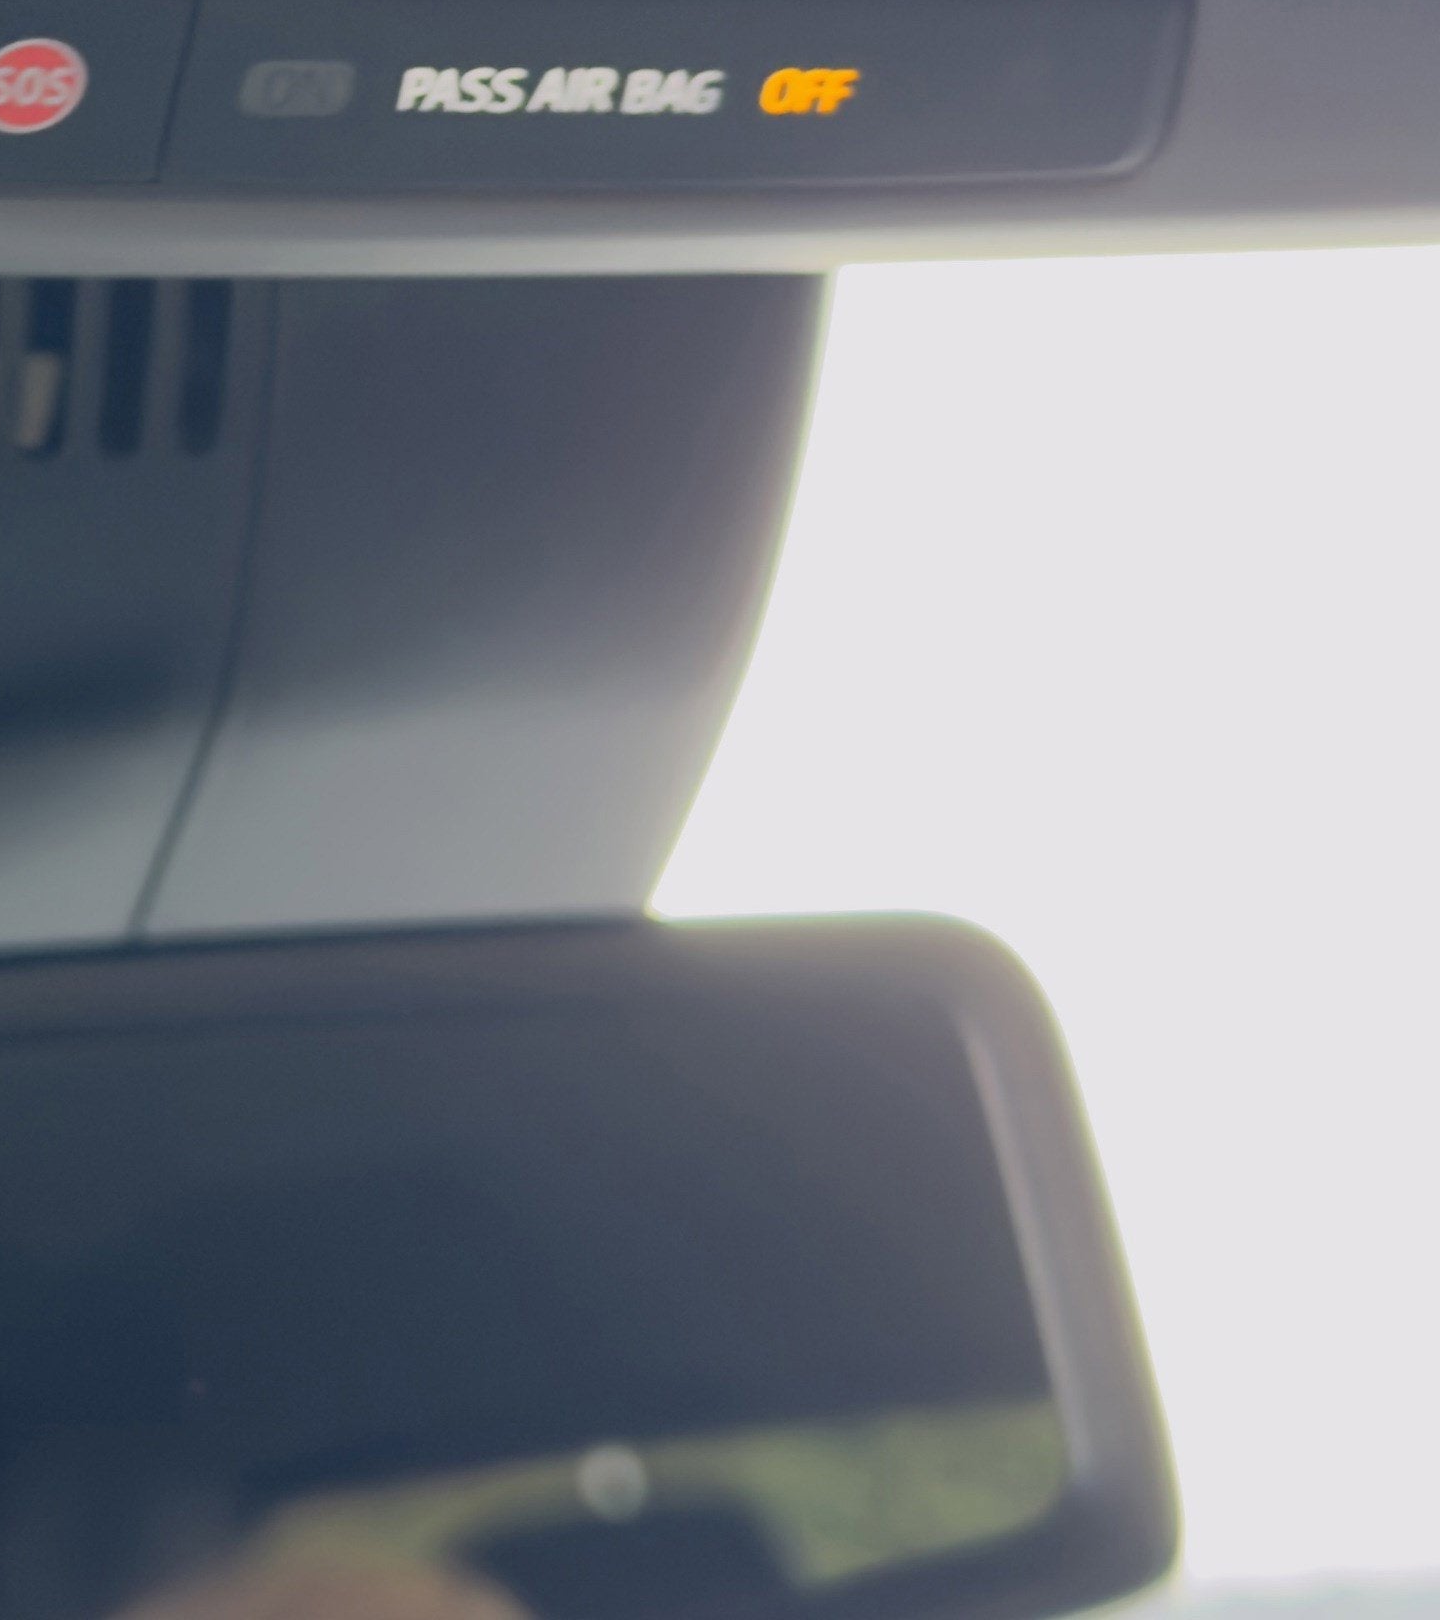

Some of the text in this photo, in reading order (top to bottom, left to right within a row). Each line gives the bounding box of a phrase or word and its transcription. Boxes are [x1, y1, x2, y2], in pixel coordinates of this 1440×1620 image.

[395, 66, 726, 116] PASS AIR BAG
[757, 67, 862, 115] OFF
